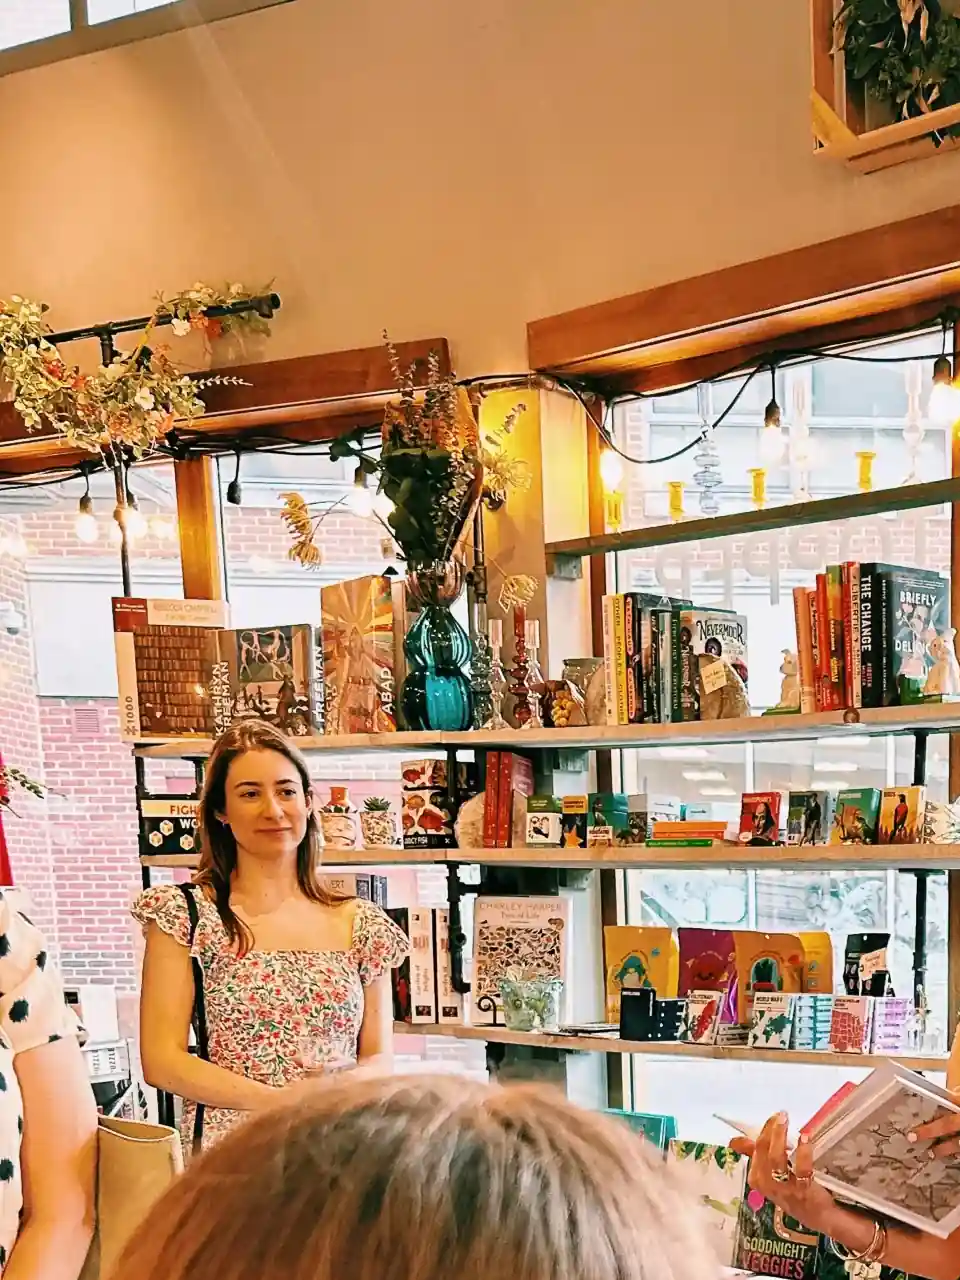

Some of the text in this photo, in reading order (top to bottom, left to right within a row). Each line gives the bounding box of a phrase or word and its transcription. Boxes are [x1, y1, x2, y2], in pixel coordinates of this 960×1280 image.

[852, 584, 860, 634] LIBERTIE
[861, 575, 872, 652] THE CHANGE
[900, 590, 937, 606] BRIEFLY
[212, 664, 222, 737] KATHRYN
[313, 646, 325, 723] FREEMAN
[381, 667, 393, 715] ABAD
[125, 696, 133, 723] 1000
[170, 805, 197, 815] FIGH
[742, 1251, 805, 1280] VEGGIES
[743, 1236, 808, 1260] GOODNIGHT
